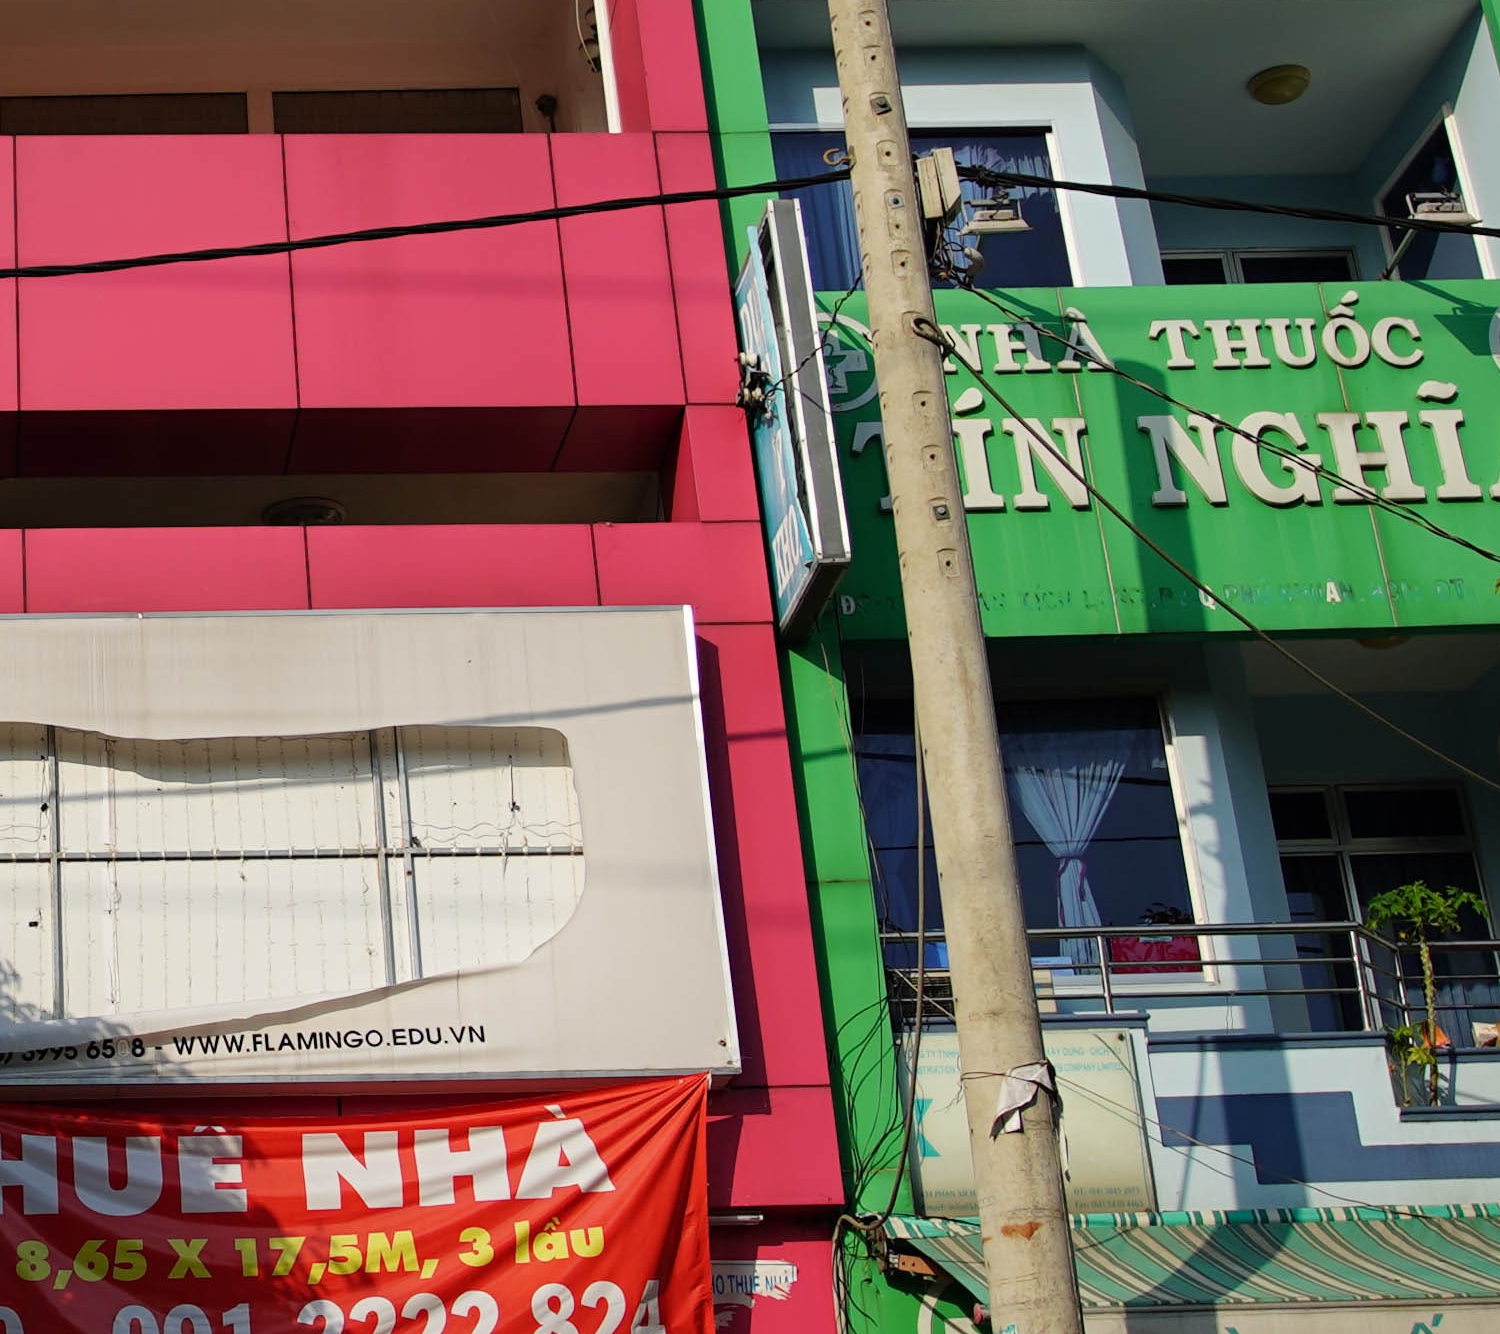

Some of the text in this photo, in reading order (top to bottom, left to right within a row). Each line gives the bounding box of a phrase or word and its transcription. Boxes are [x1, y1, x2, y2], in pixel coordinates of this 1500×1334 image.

[938, 289, 1427, 375] NHÀ THUỐC
[172, 1024, 486, 1059] WWW.FLAMINGO.EDU.VN
[302, 1103, 615, 1211] NHÀ
[15, 1237, 148, 1296] 8,65
[166, 1237, 214, 1283] X
[236, 1225, 438, 1289] 17,5M,
[458, 1225, 493, 1269] 3
[515, 1219, 604, 1266] lầu
